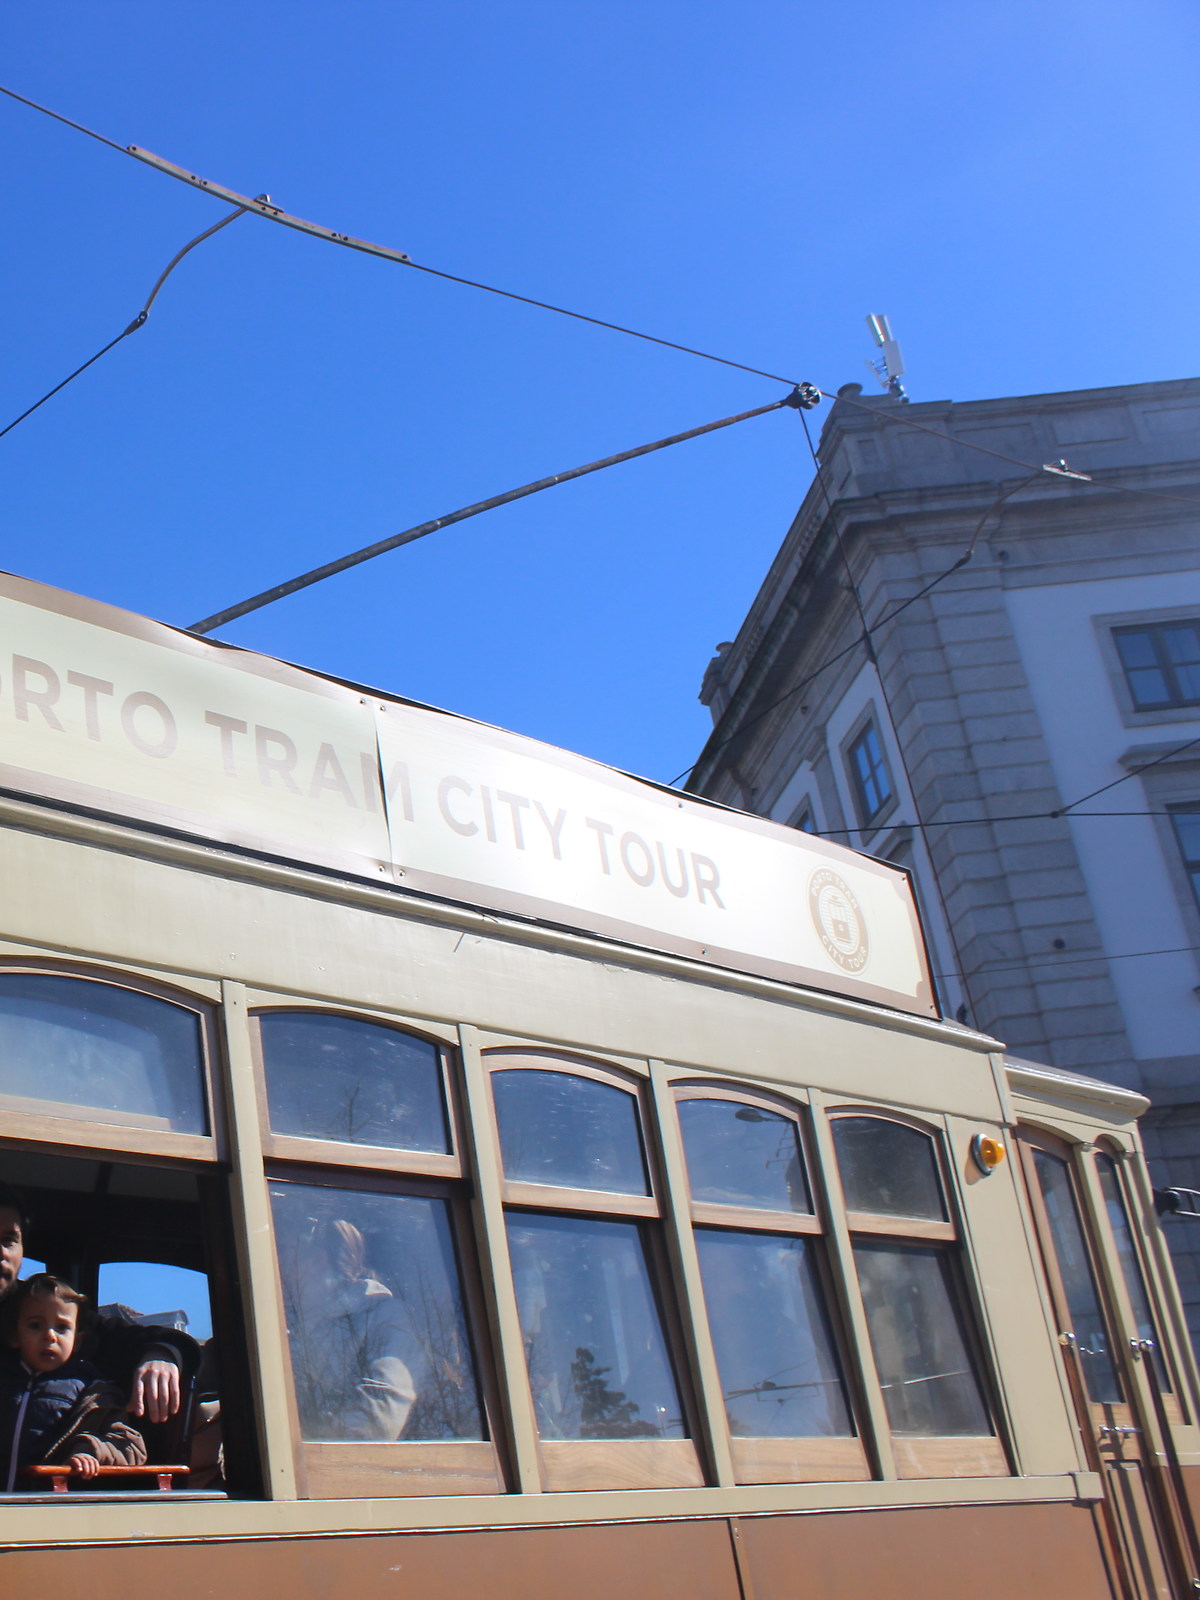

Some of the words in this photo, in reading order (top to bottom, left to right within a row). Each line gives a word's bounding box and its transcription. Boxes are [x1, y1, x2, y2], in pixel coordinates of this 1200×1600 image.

[204, 711, 414, 822] TRAM
[437, 775, 566, 861] CITY
[586, 817, 726, 909] TOUR
[811, 871, 832, 896] PORTO
[822, 935, 844, 964] CITY
[848, 946, 867, 969] TOUR
